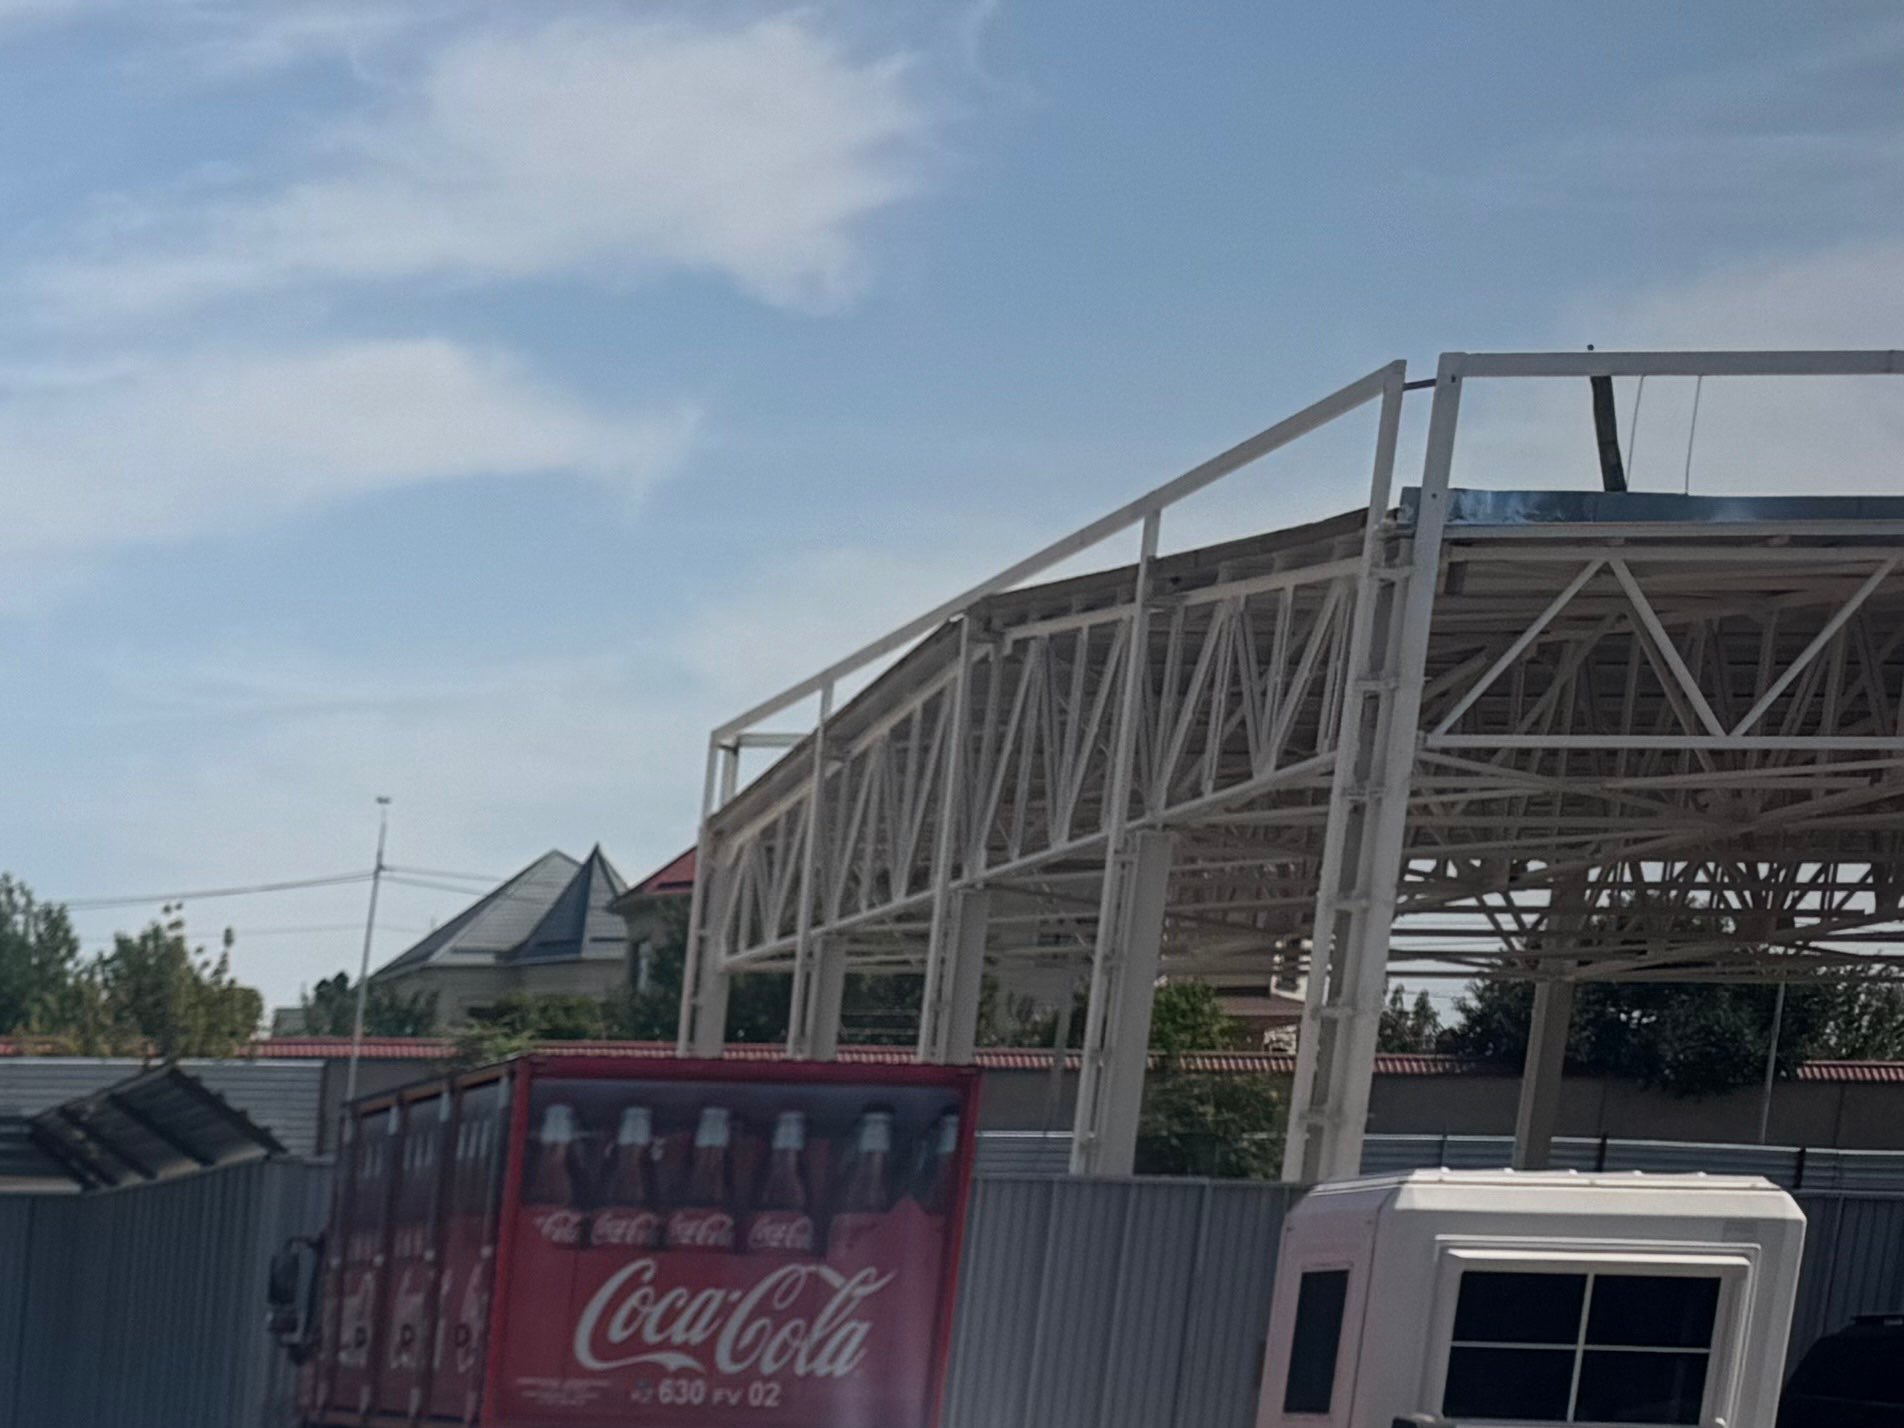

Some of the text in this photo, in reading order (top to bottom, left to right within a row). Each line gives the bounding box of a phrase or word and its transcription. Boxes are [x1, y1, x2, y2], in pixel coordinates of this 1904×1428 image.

[574, 1258, 896, 1378] Coca-Cola
[659, 1379, 706, 1406] 630
[748, 1381, 782, 1408] 02
